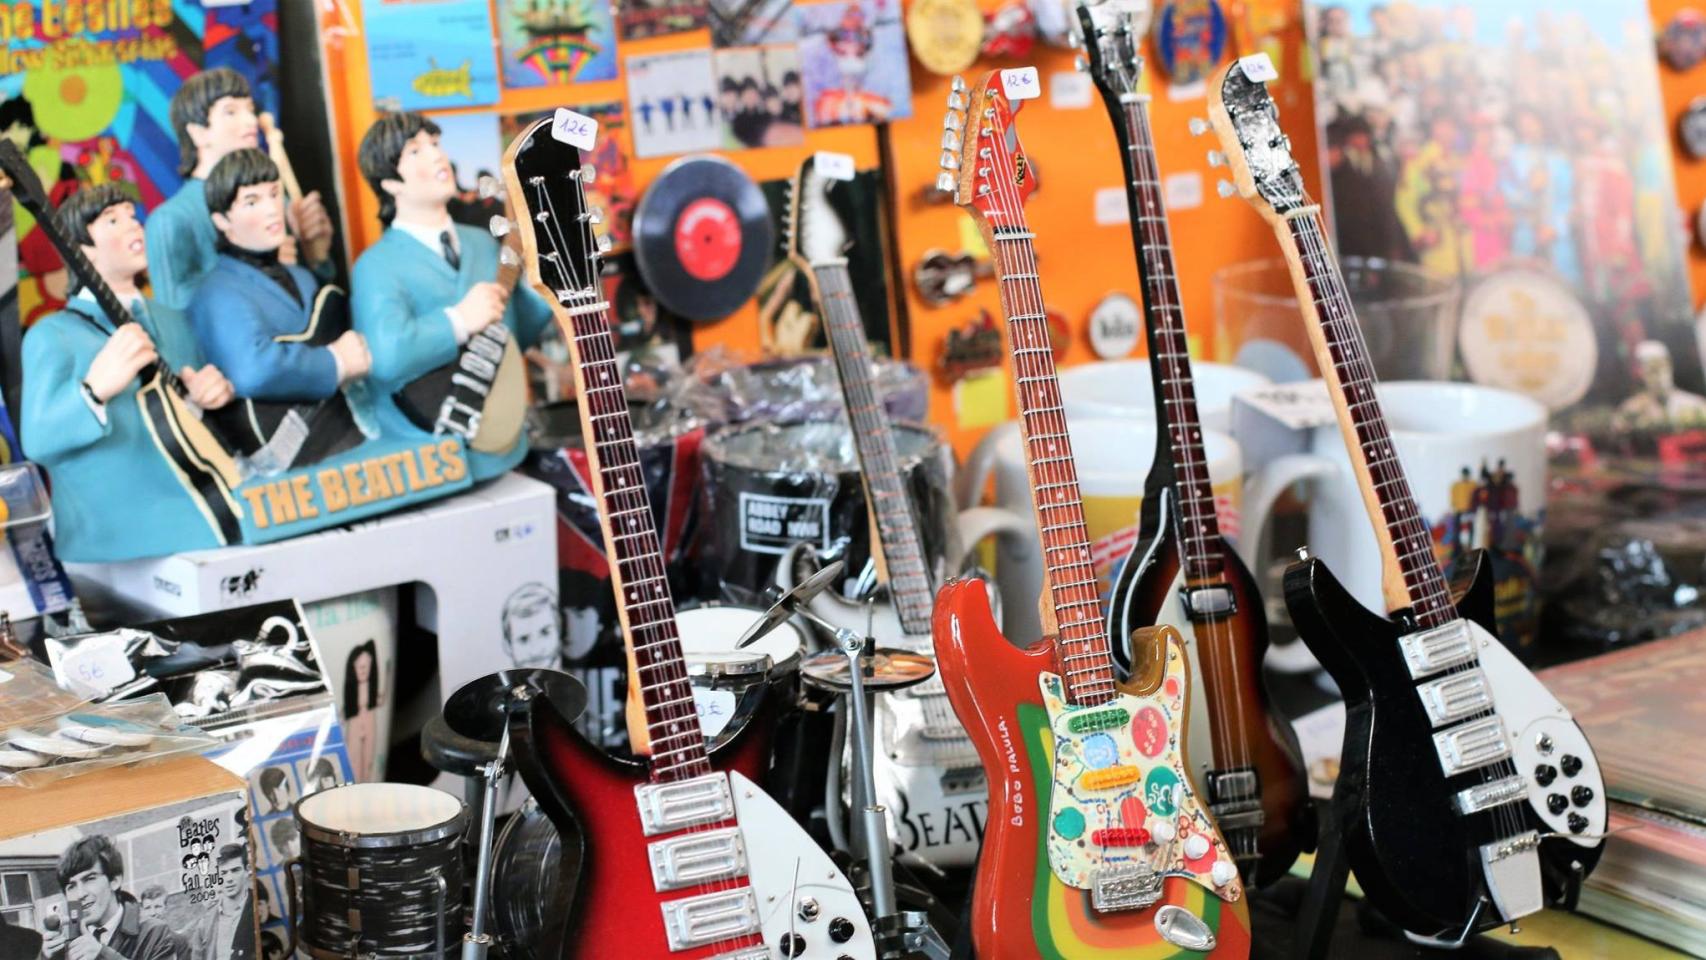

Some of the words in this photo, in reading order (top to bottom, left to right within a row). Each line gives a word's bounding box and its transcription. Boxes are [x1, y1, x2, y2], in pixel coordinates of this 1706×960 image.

[560, 118, 588, 137] 12€
[242, 473, 319, 529] THE
[317, 439, 466, 513] BEATLES
[747, 501, 789, 519] ABBEY
[747, 518, 782, 535] ROAD
[897, 790, 990, 851] BEAT
[190, 889, 216, 904] 2009
